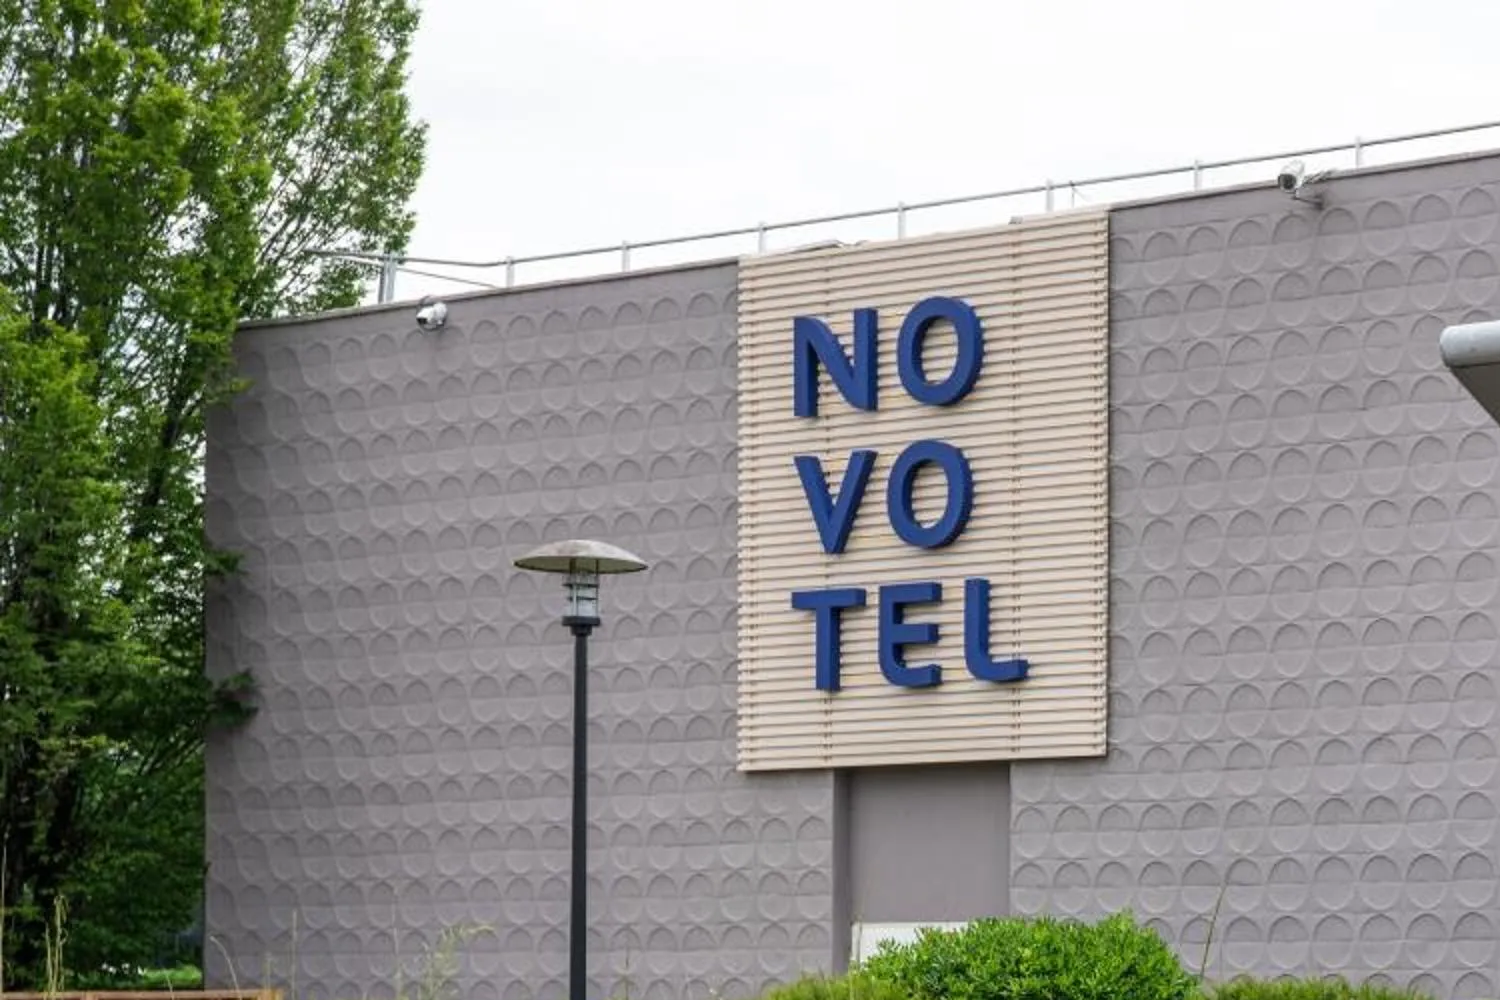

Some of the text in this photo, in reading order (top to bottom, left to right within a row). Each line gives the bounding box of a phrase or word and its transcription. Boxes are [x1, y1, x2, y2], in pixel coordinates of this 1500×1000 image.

[793, 295, 984, 418] NO
[794, 438, 974, 554] VO
[791, 577, 1030, 692] TEL
